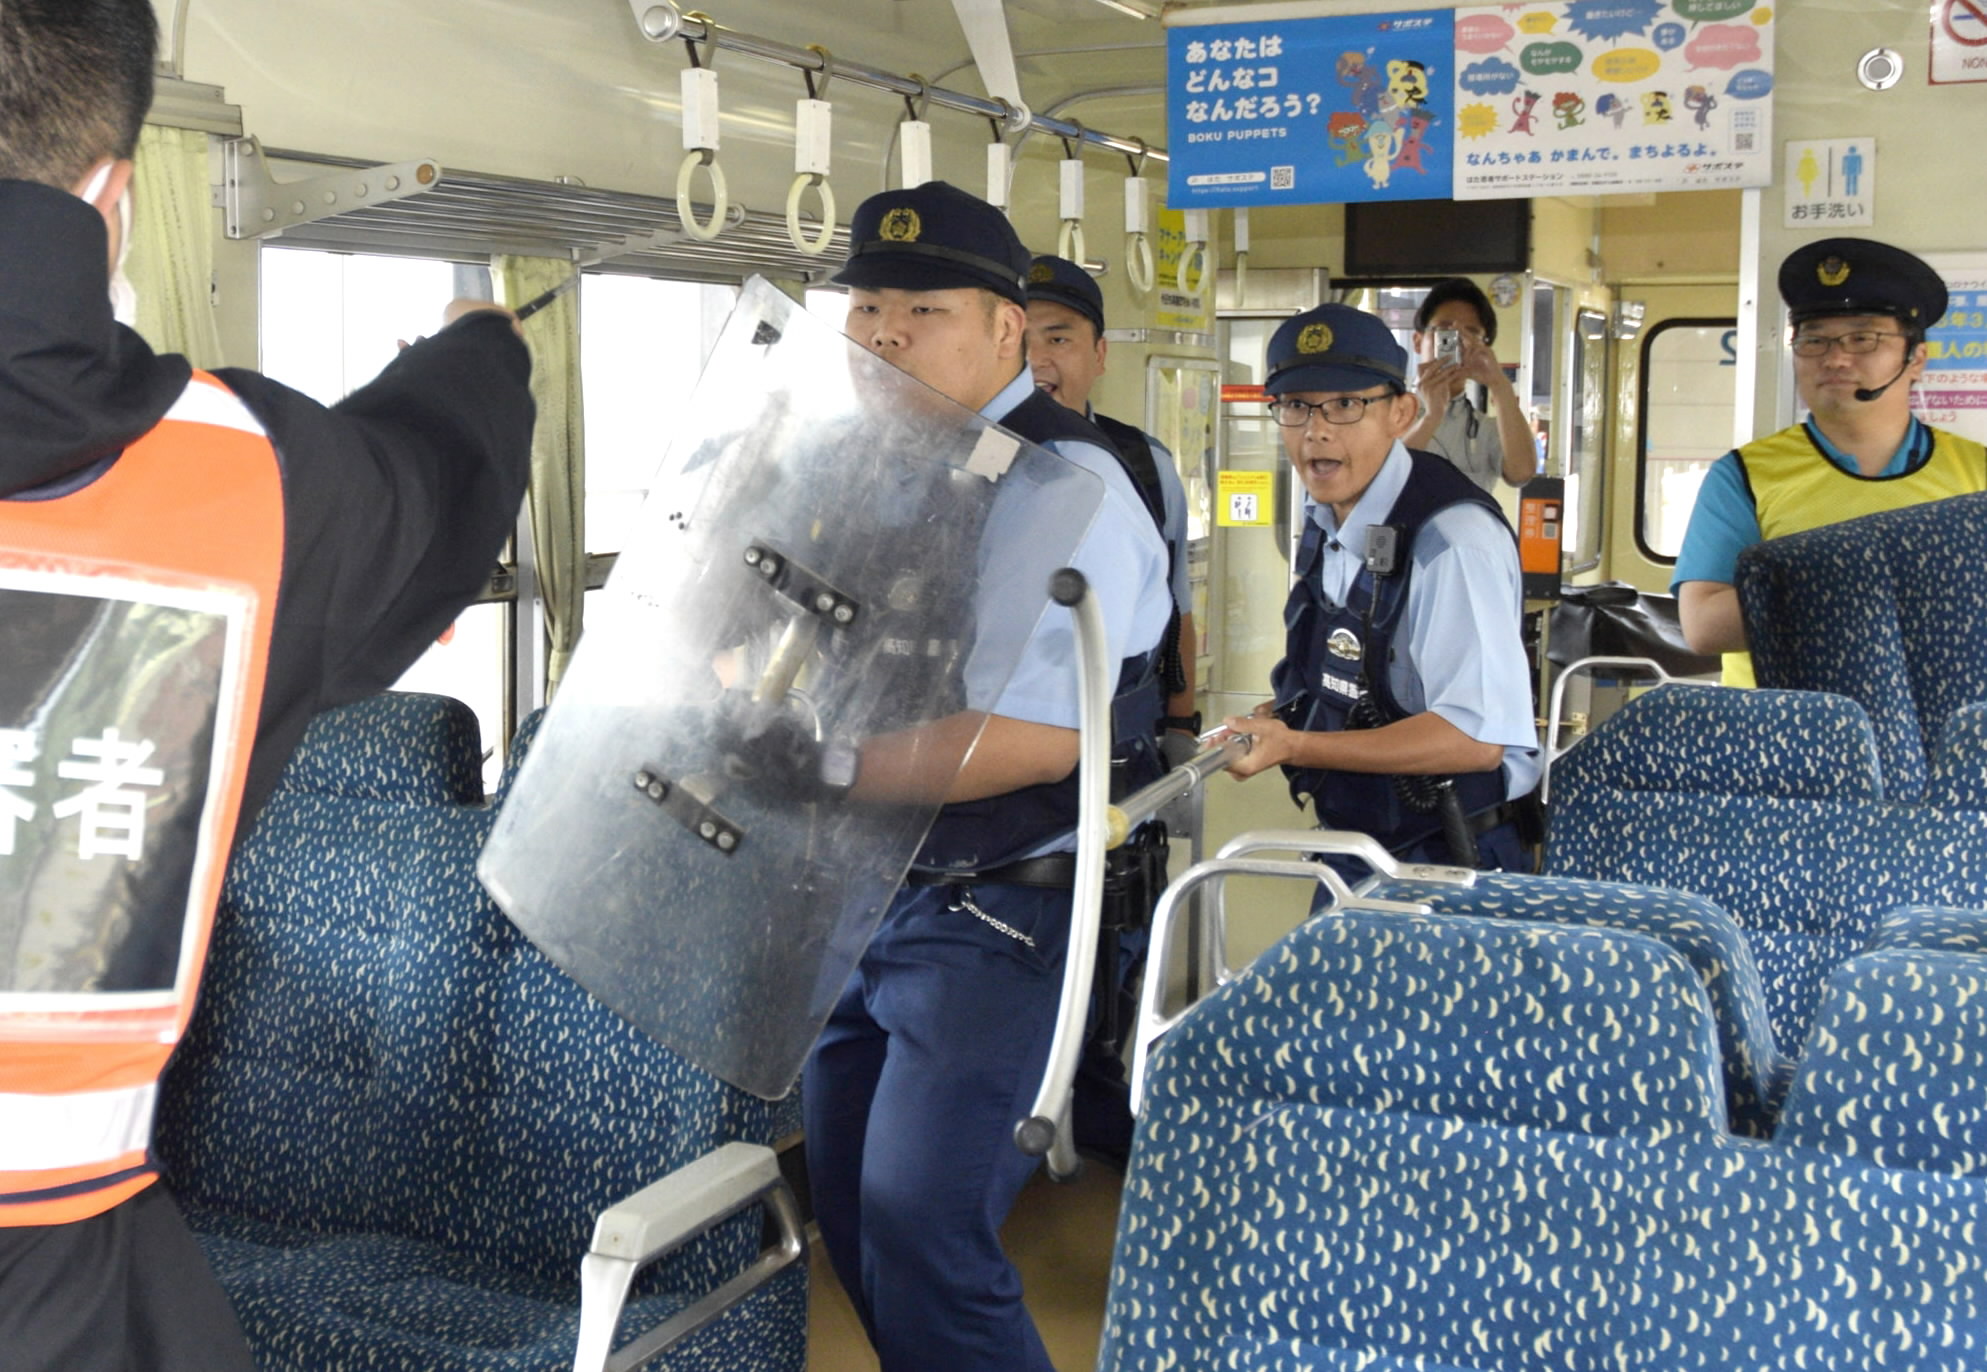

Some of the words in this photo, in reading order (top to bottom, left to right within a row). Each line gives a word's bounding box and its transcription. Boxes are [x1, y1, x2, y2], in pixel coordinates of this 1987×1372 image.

[1186, 35, 1283, 63] あなたは
[1186, 67, 1278, 93] どんなコ
[1186, 93, 1321, 122] なんだろう？
[1188, 132, 1222, 143] BOKU
[1227, 128, 1287, 140] PUPPETS
[1466, 150, 1542, 166] なんちゃあ
[1791, 202, 1864, 220] お手洗い
[1926, 341, 1987, 358] 個人の
